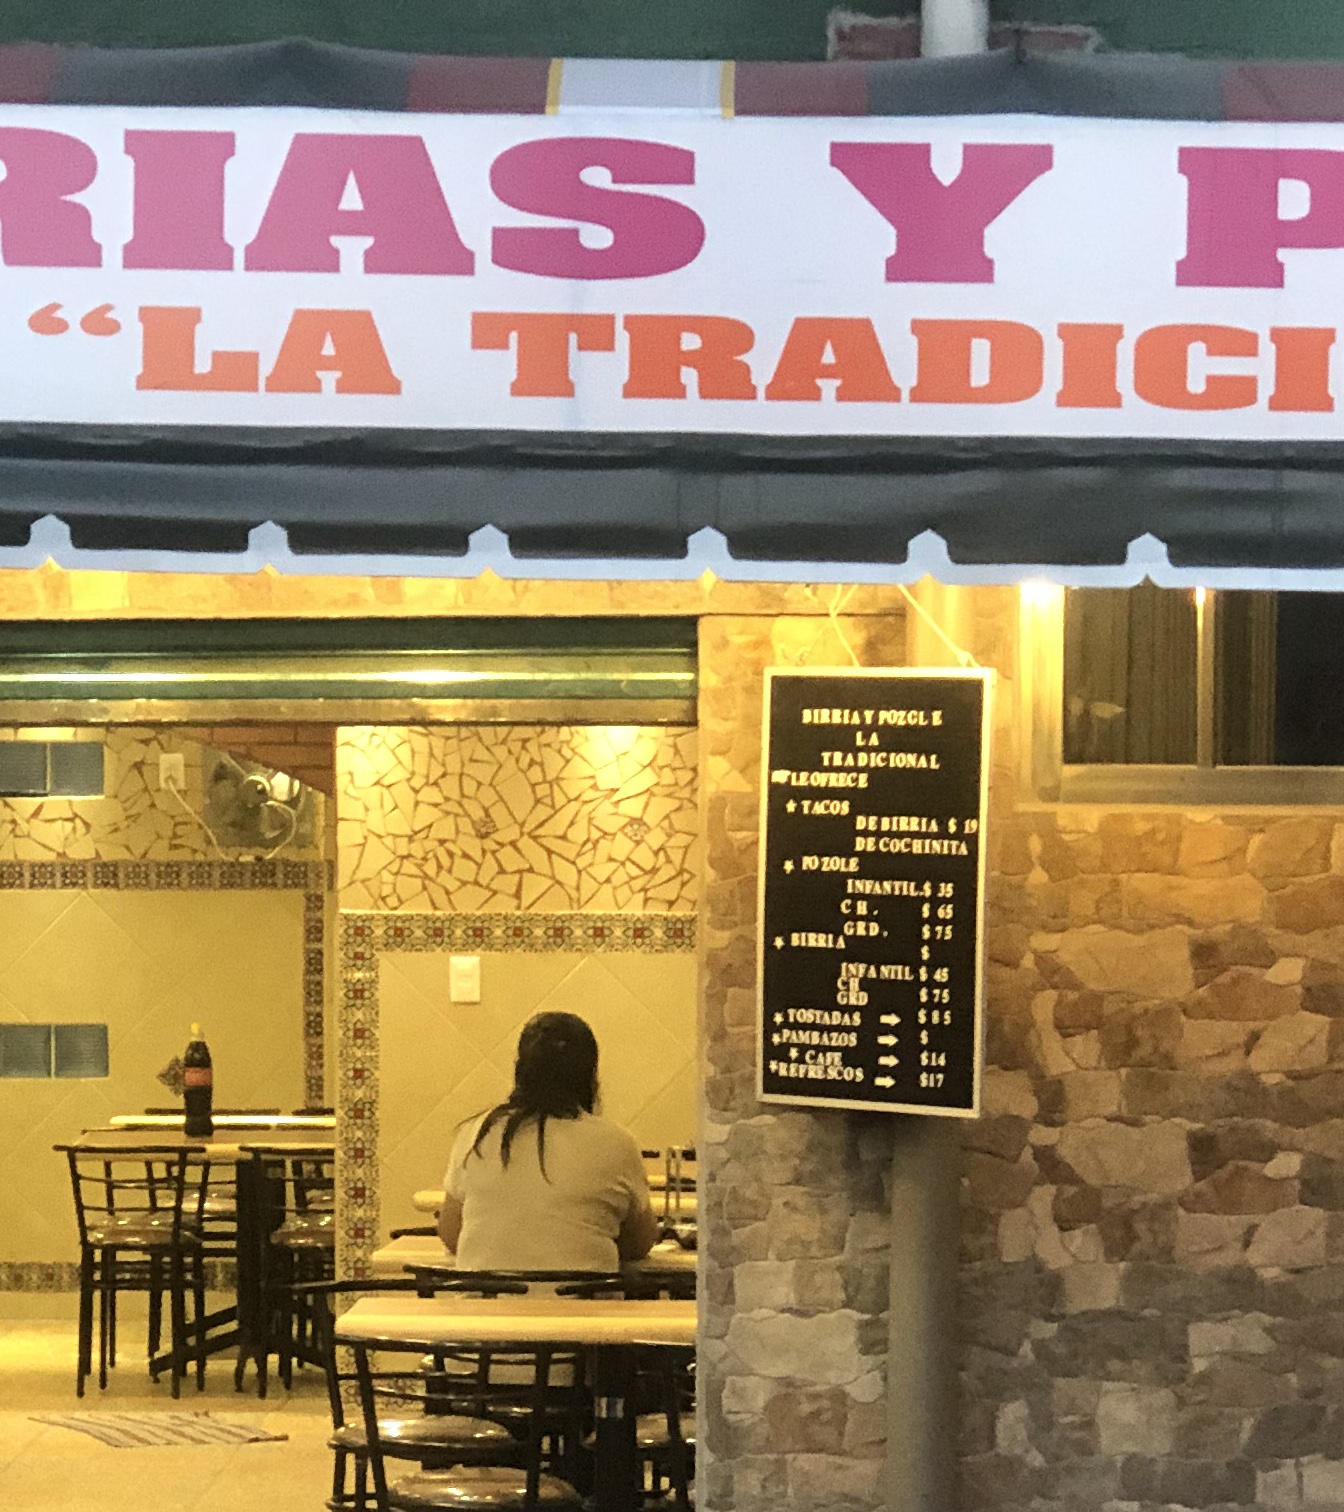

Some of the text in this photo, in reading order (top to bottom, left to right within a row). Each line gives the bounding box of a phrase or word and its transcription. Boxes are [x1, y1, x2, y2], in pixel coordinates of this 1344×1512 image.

[830, 143, 1052, 283] Y
[29, 303, 402, 395] “LA
[802, 708, 860, 725] BIRRIA
[856, 731, 879, 747] LA
[821, 751, 940, 769] TRADICIONAL
[801, 800, 850, 815] TACOS
[856, 815, 878, 831] DE
[881, 816, 938, 832] BIRRIA
[854, 837, 968, 855] DE COCHINITA
[790, 932, 847, 949] BIRRIA
[840, 962, 914, 980] INFANTIL
[787, 1009, 861, 1026] TOSTADAS
[781, 1029, 857, 1047] PAMBAZOS
[805, 1050, 843, 1066] CAFE
[778, 1062, 864, 1082] REFRESCOS
